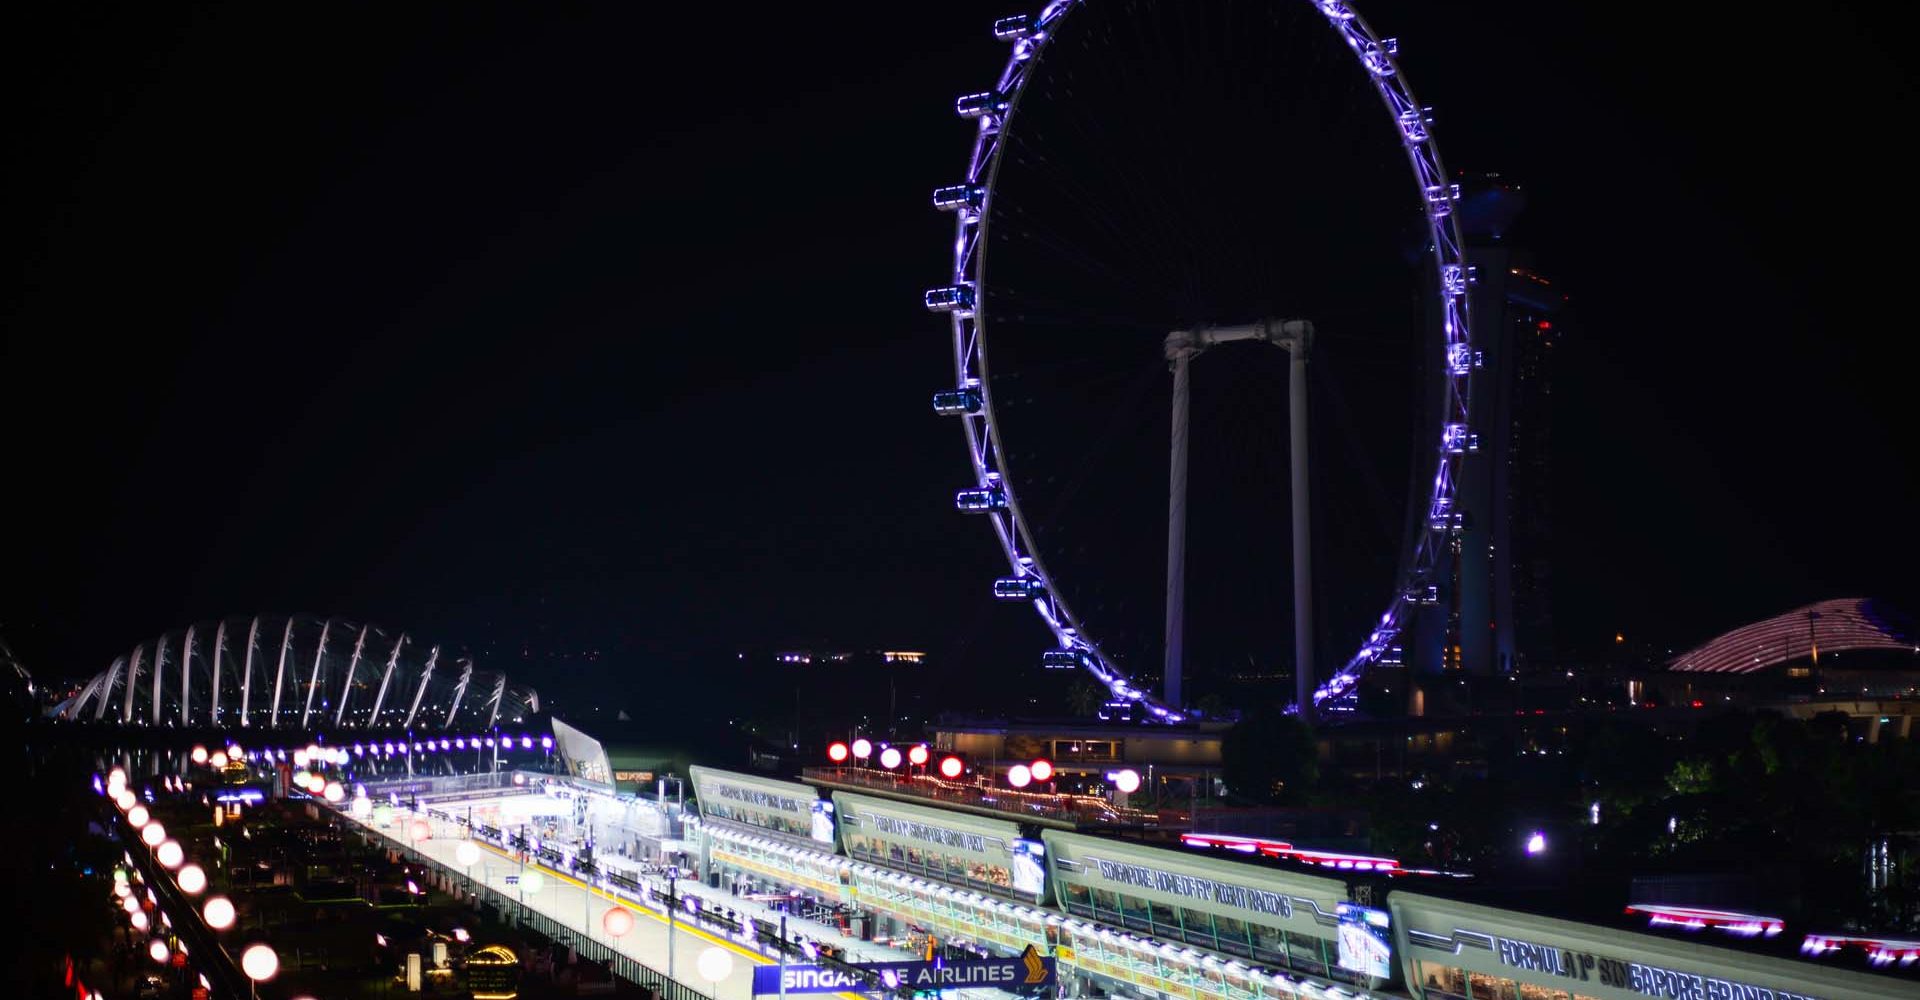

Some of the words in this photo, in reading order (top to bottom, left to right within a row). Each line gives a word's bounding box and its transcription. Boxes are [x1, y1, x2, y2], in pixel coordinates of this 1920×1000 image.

[1213, 882, 1248, 909] NIGHT
[1248, 888, 1293, 919] RACING
[917, 965, 1015, 984] AIRLINES
[1498, 937, 1575, 979] FORMULA
[1598, 957, 1704, 1000] SINGAPORE
